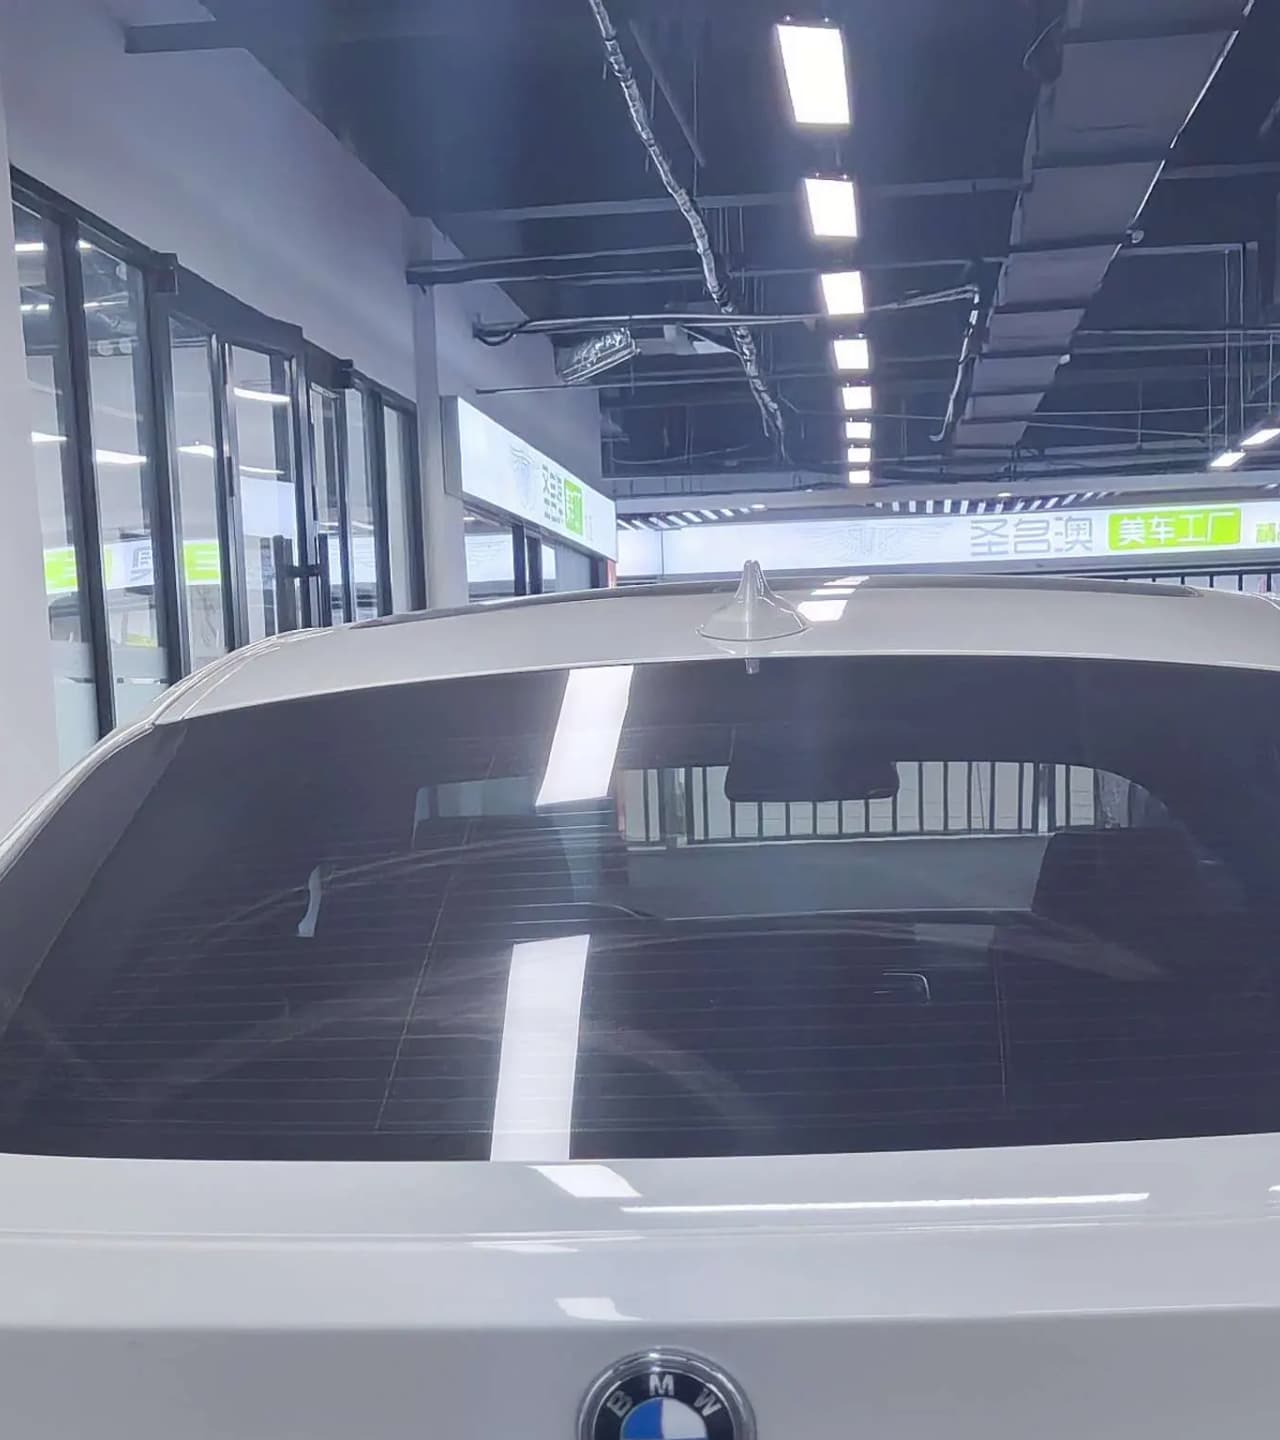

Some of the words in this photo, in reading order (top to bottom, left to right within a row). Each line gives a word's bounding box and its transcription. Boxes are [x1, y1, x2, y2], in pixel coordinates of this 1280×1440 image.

[970, 515, 1094, 557] 圣名澳
[1118, 511, 1238, 546] 美车工厂
[606, 1373, 723, 1418] BMW
